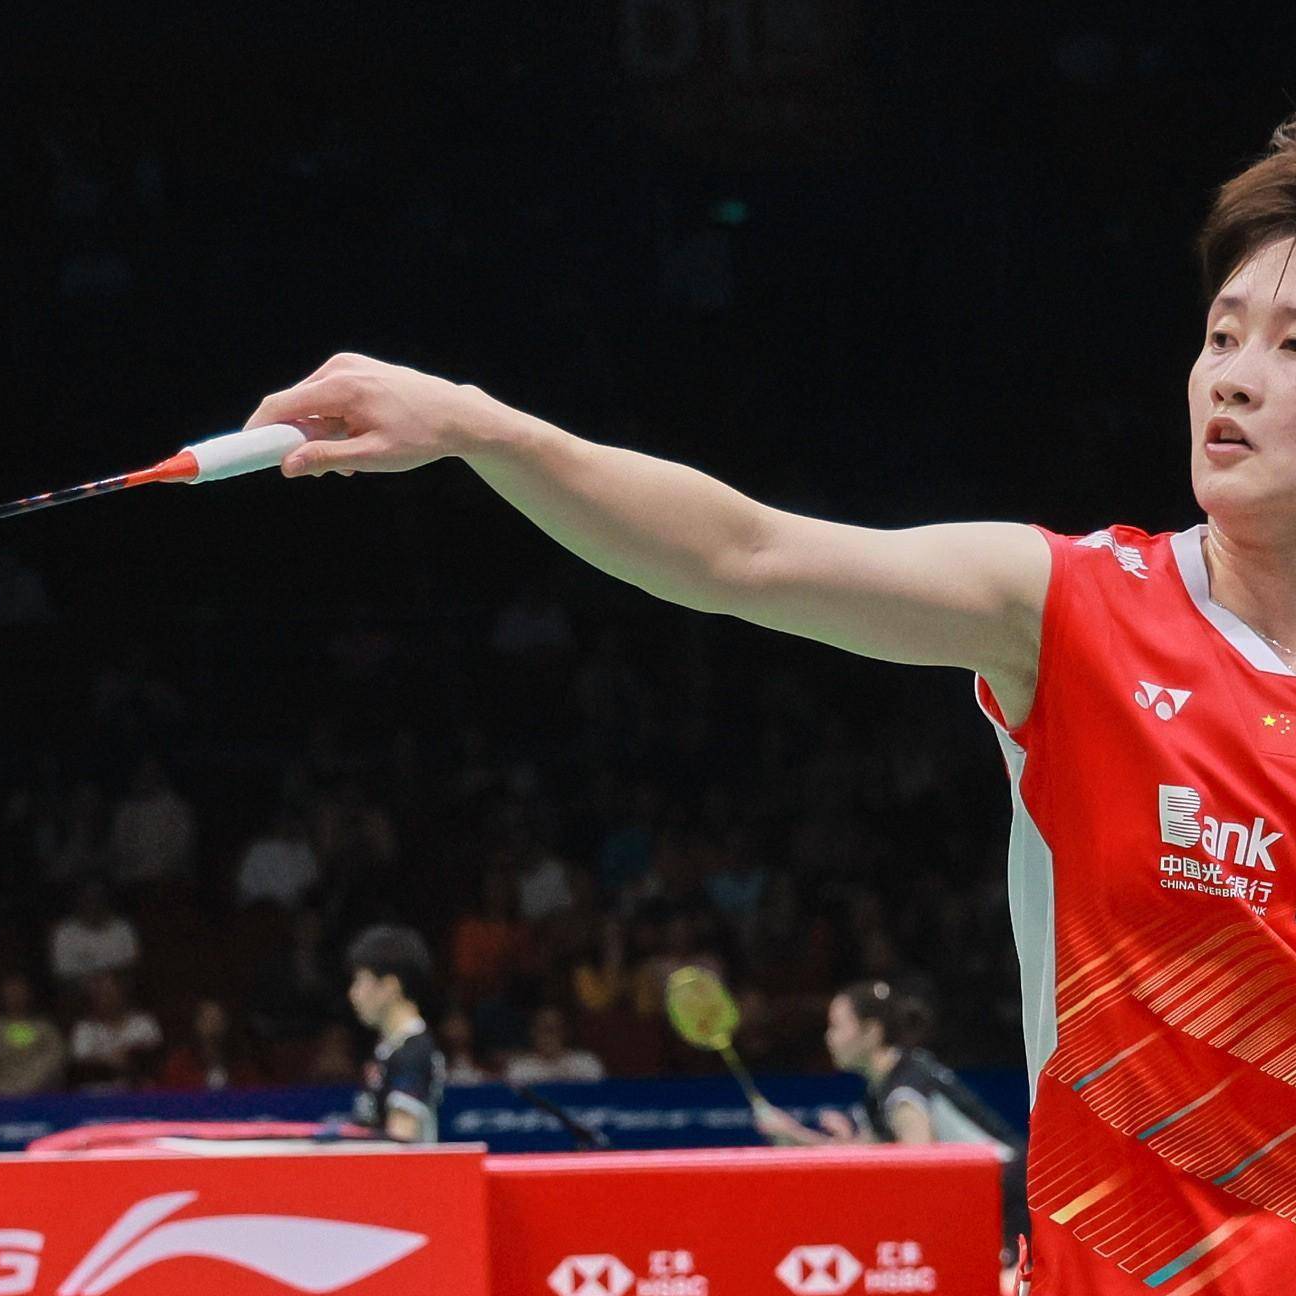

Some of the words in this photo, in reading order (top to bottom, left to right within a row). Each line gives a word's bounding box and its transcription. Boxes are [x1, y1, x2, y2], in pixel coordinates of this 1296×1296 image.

[1159, 784, 1284, 872] Bank
[1159, 855, 1273, 903] 中国光银行
[1160, 879, 1196, 892] CHINA
